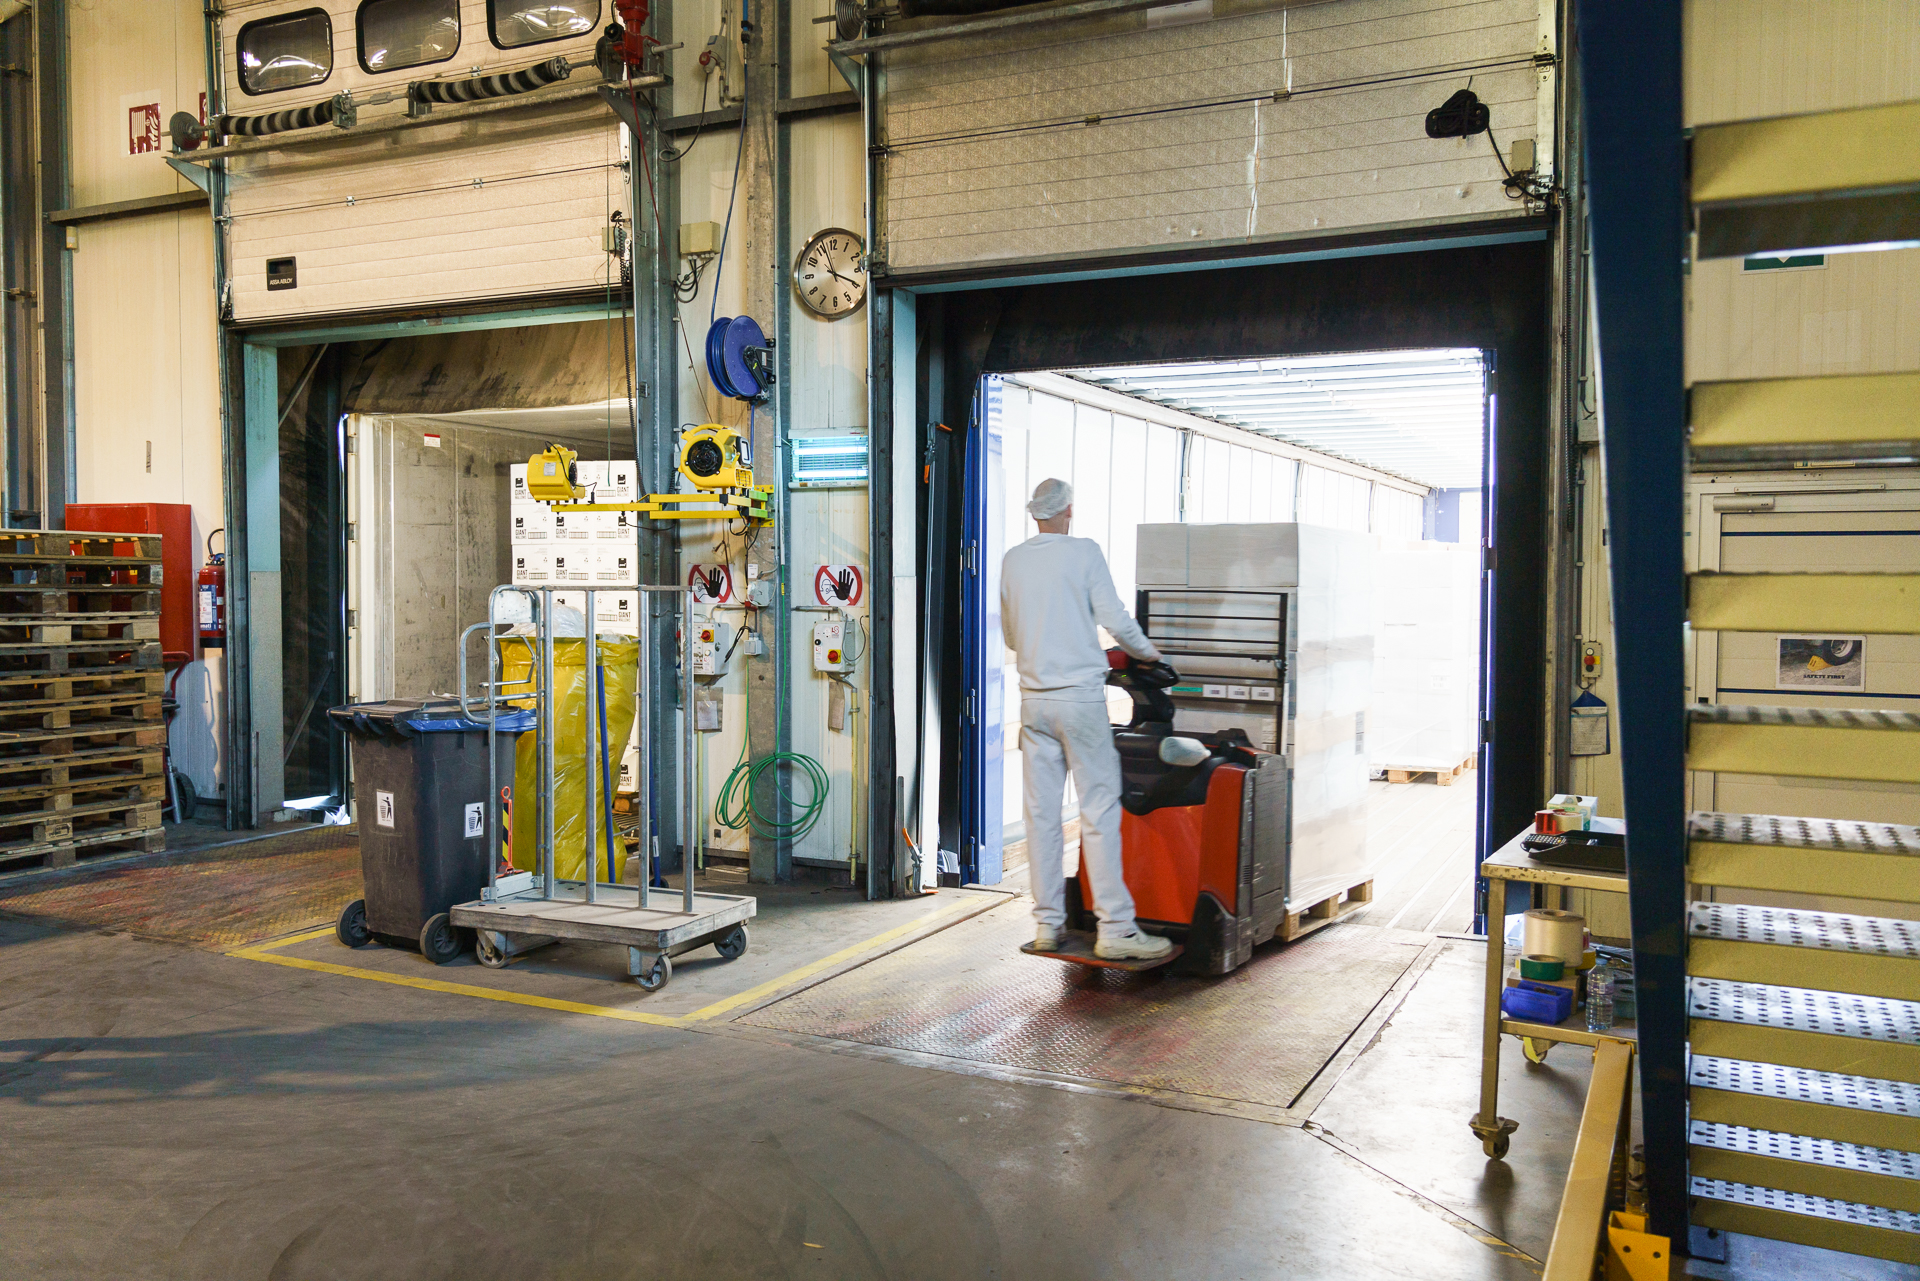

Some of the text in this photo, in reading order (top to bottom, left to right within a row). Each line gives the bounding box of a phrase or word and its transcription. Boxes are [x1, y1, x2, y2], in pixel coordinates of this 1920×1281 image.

[829, 239, 838, 251] 12
[843, 242, 849, 252] 1
[808, 257, 818, 268] 10
[850, 252, 860, 262] 2
[809, 286, 818, 296] 8
[844, 291, 852, 302] 5
[820, 294, 827, 305] 7
[833, 296, 838, 308] 6
